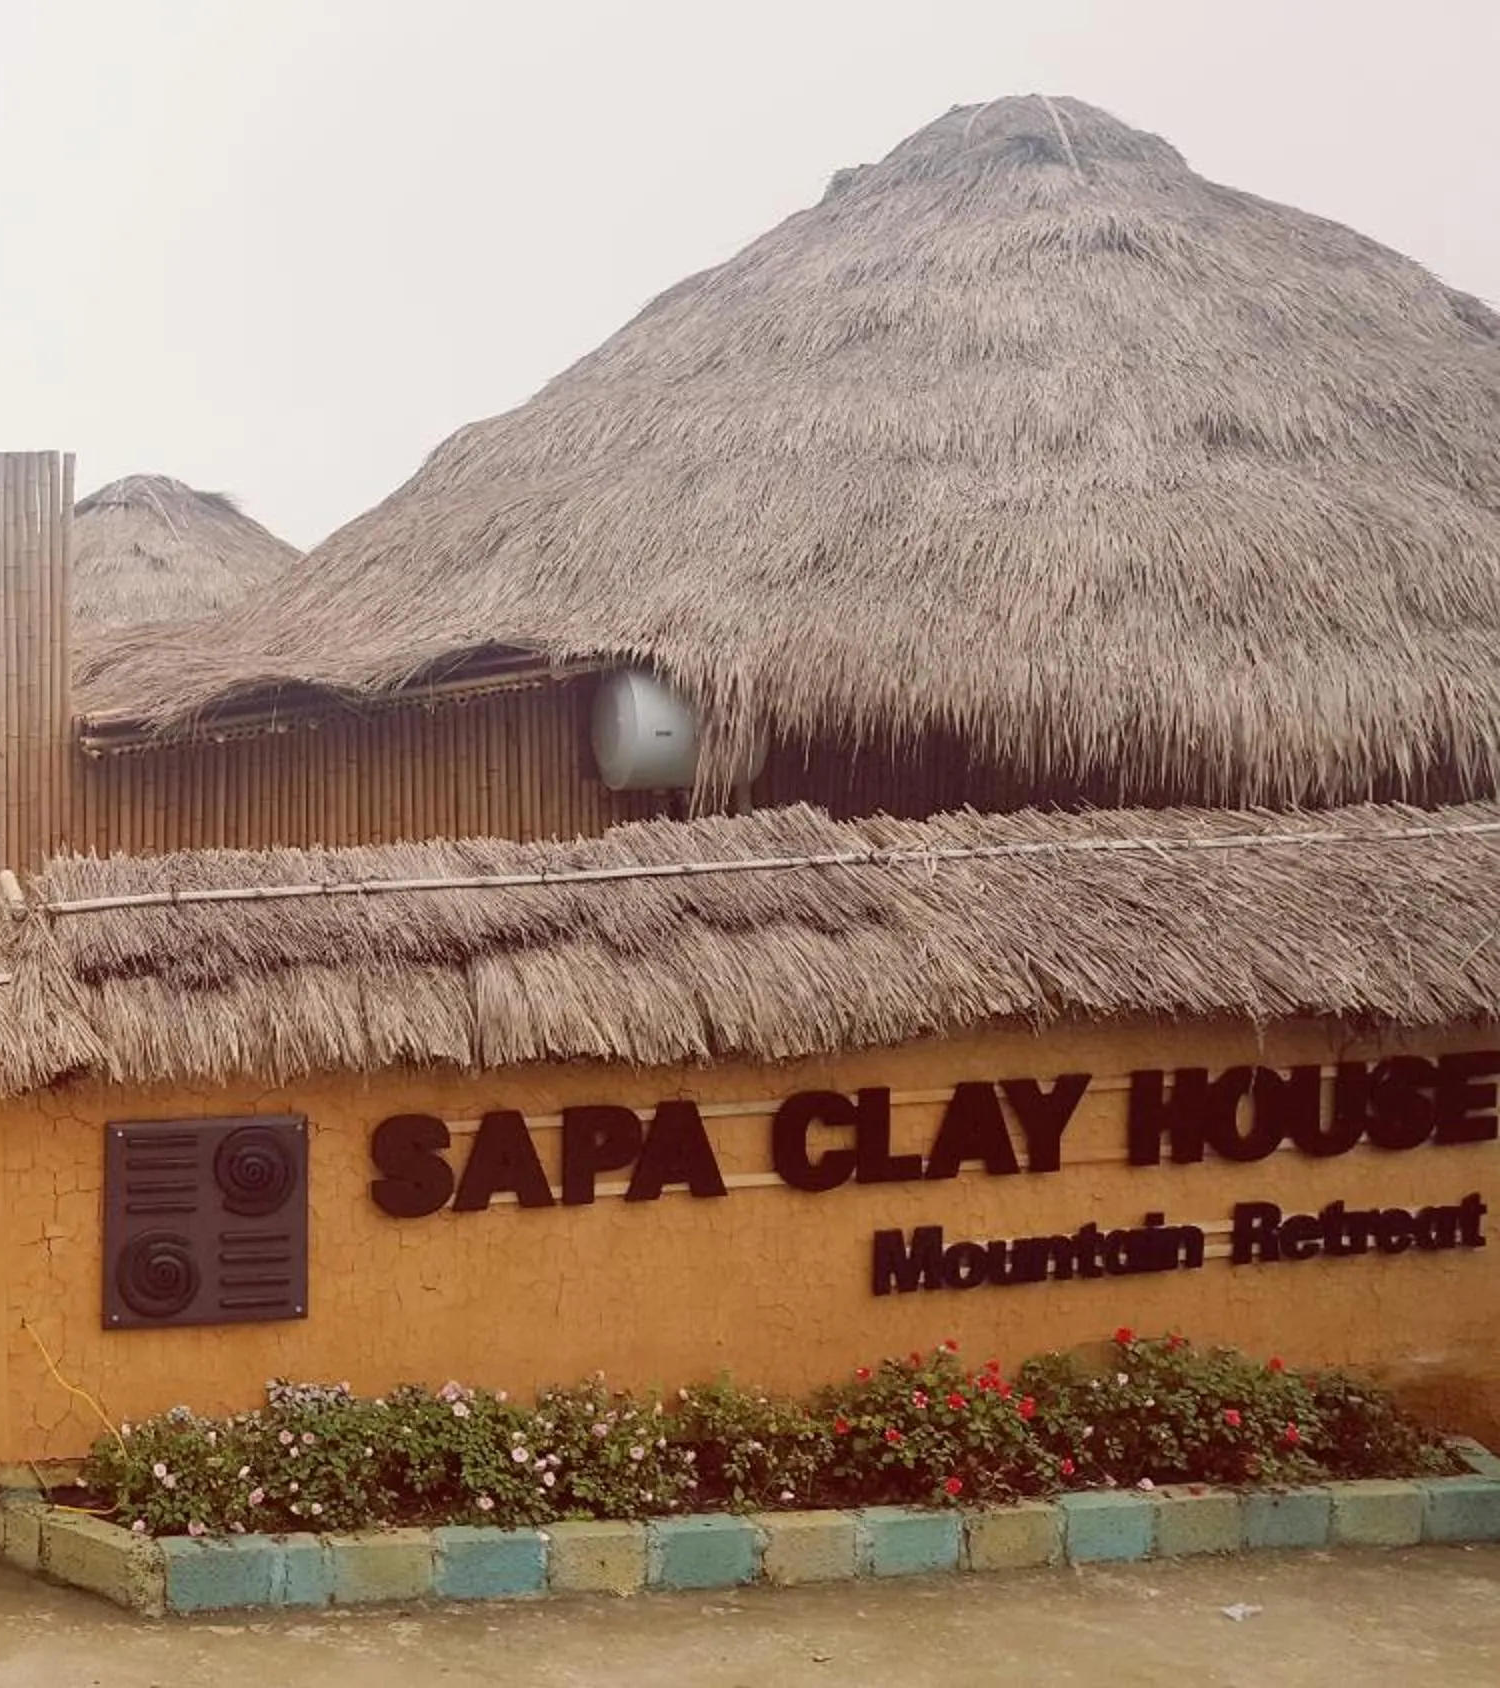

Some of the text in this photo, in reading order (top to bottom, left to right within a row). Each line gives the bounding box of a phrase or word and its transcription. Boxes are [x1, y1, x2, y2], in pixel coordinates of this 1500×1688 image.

[370, 1050, 1500, 1219] SAPA CLAY HOUSE
[872, 1192, 1488, 1297] Mountain Retreat
